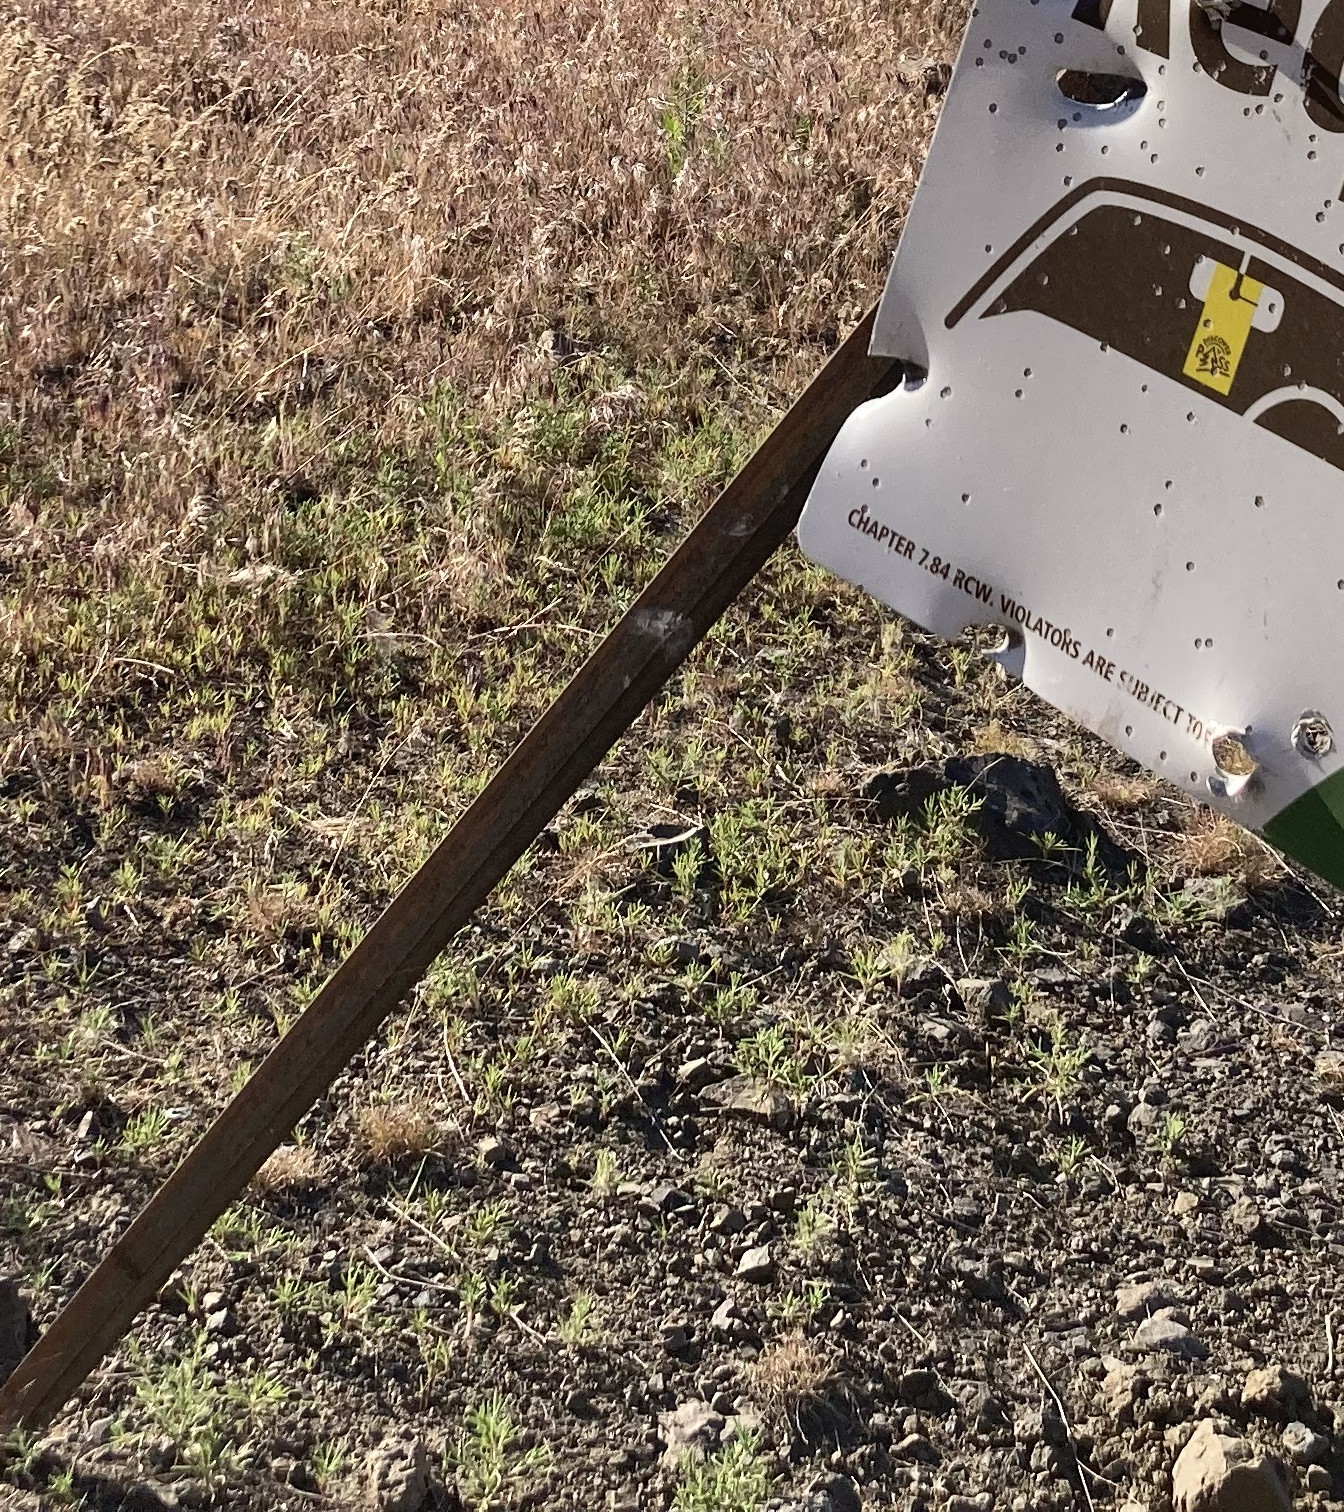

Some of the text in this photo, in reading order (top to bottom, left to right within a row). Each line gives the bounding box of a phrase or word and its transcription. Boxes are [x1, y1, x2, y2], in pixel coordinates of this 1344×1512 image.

[848, 508, 916, 561] CHAPTER
[918, 548, 951, 580] 7.84
[953, 568, 994, 607] RCW.
[1001, 594, 1082, 659] VIOLATORS
[1082, 649, 1116, 682] ARE
[1116, 670, 1185, 725] SUBJECT
